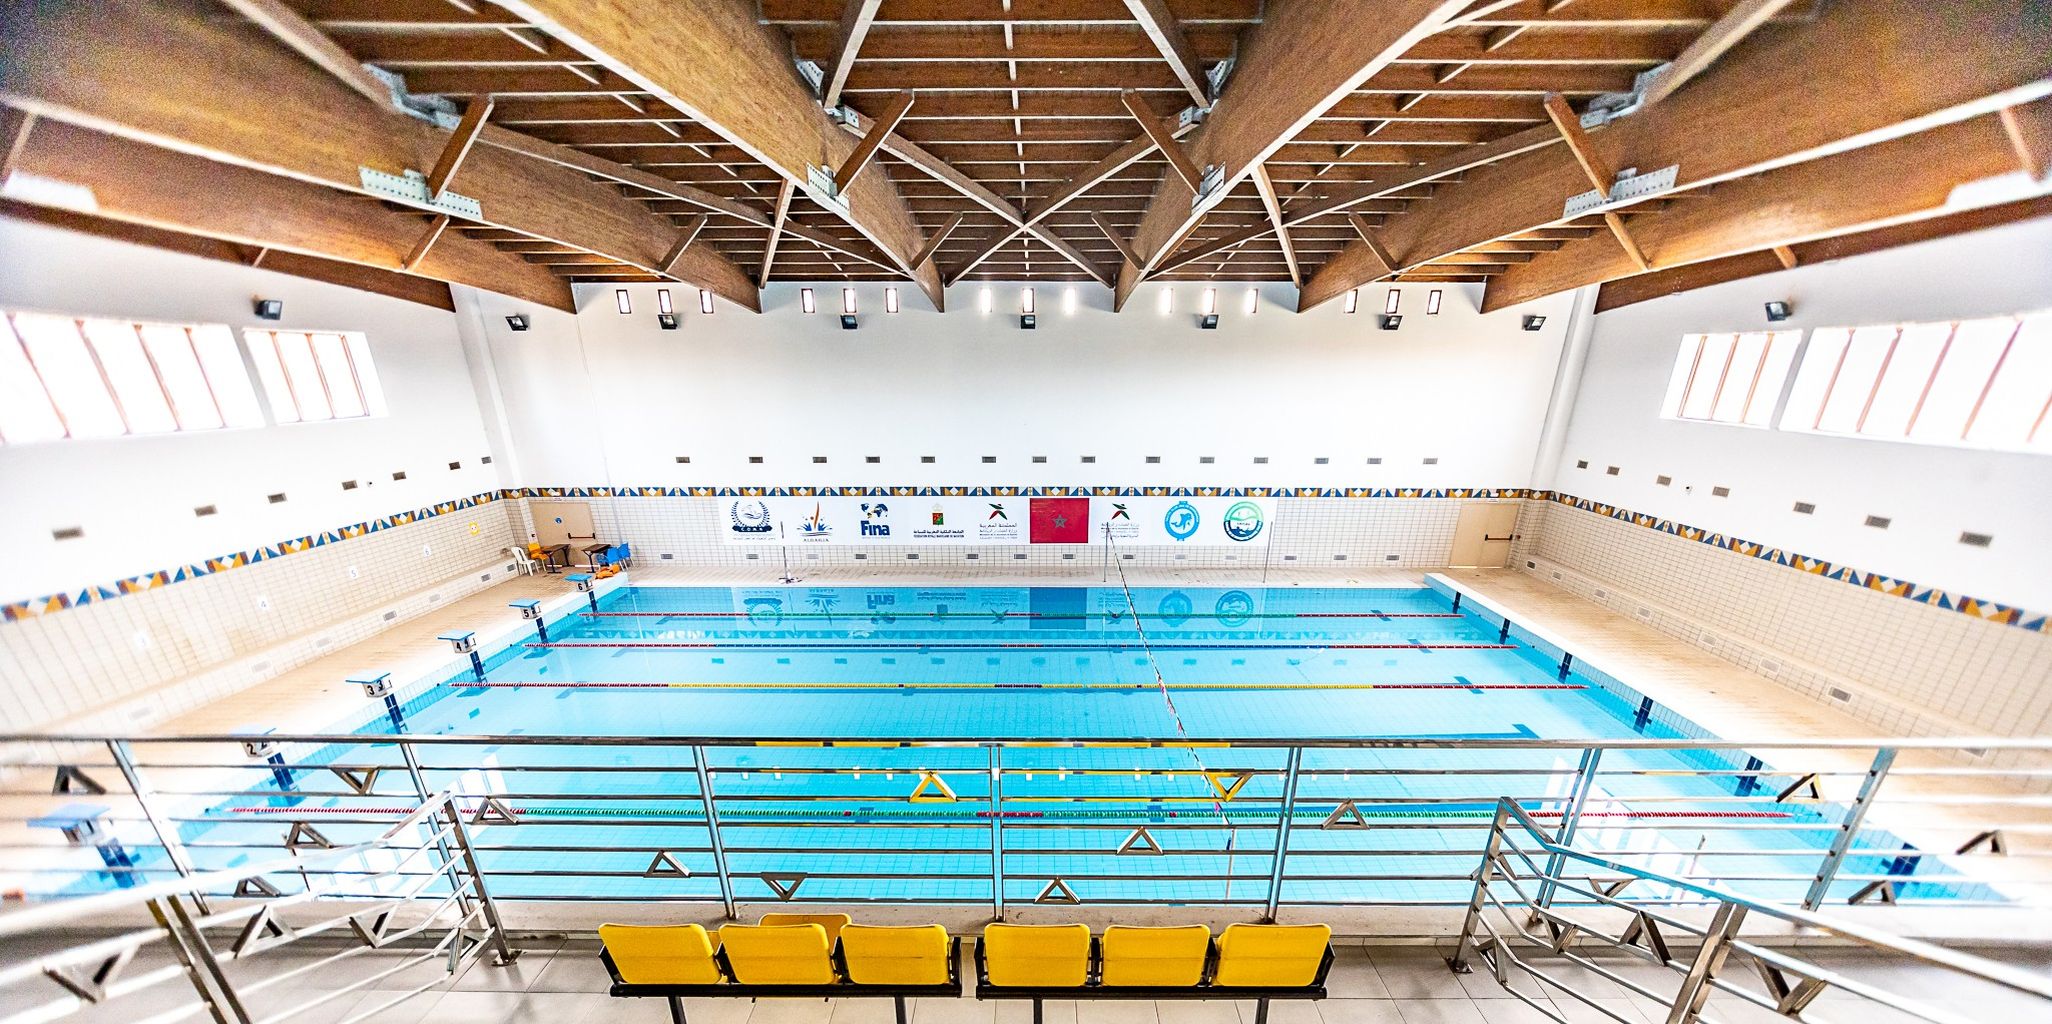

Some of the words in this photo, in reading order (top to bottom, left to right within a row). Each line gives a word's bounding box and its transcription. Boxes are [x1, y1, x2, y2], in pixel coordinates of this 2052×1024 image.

[860, 520, 890, 536] Fina
[577, 582, 583, 591] 6
[523, 608, 530, 618] 5
[456, 641, 462, 652] 4
[367, 685, 375, 696] 3
[246, 742, 257, 755] 2
